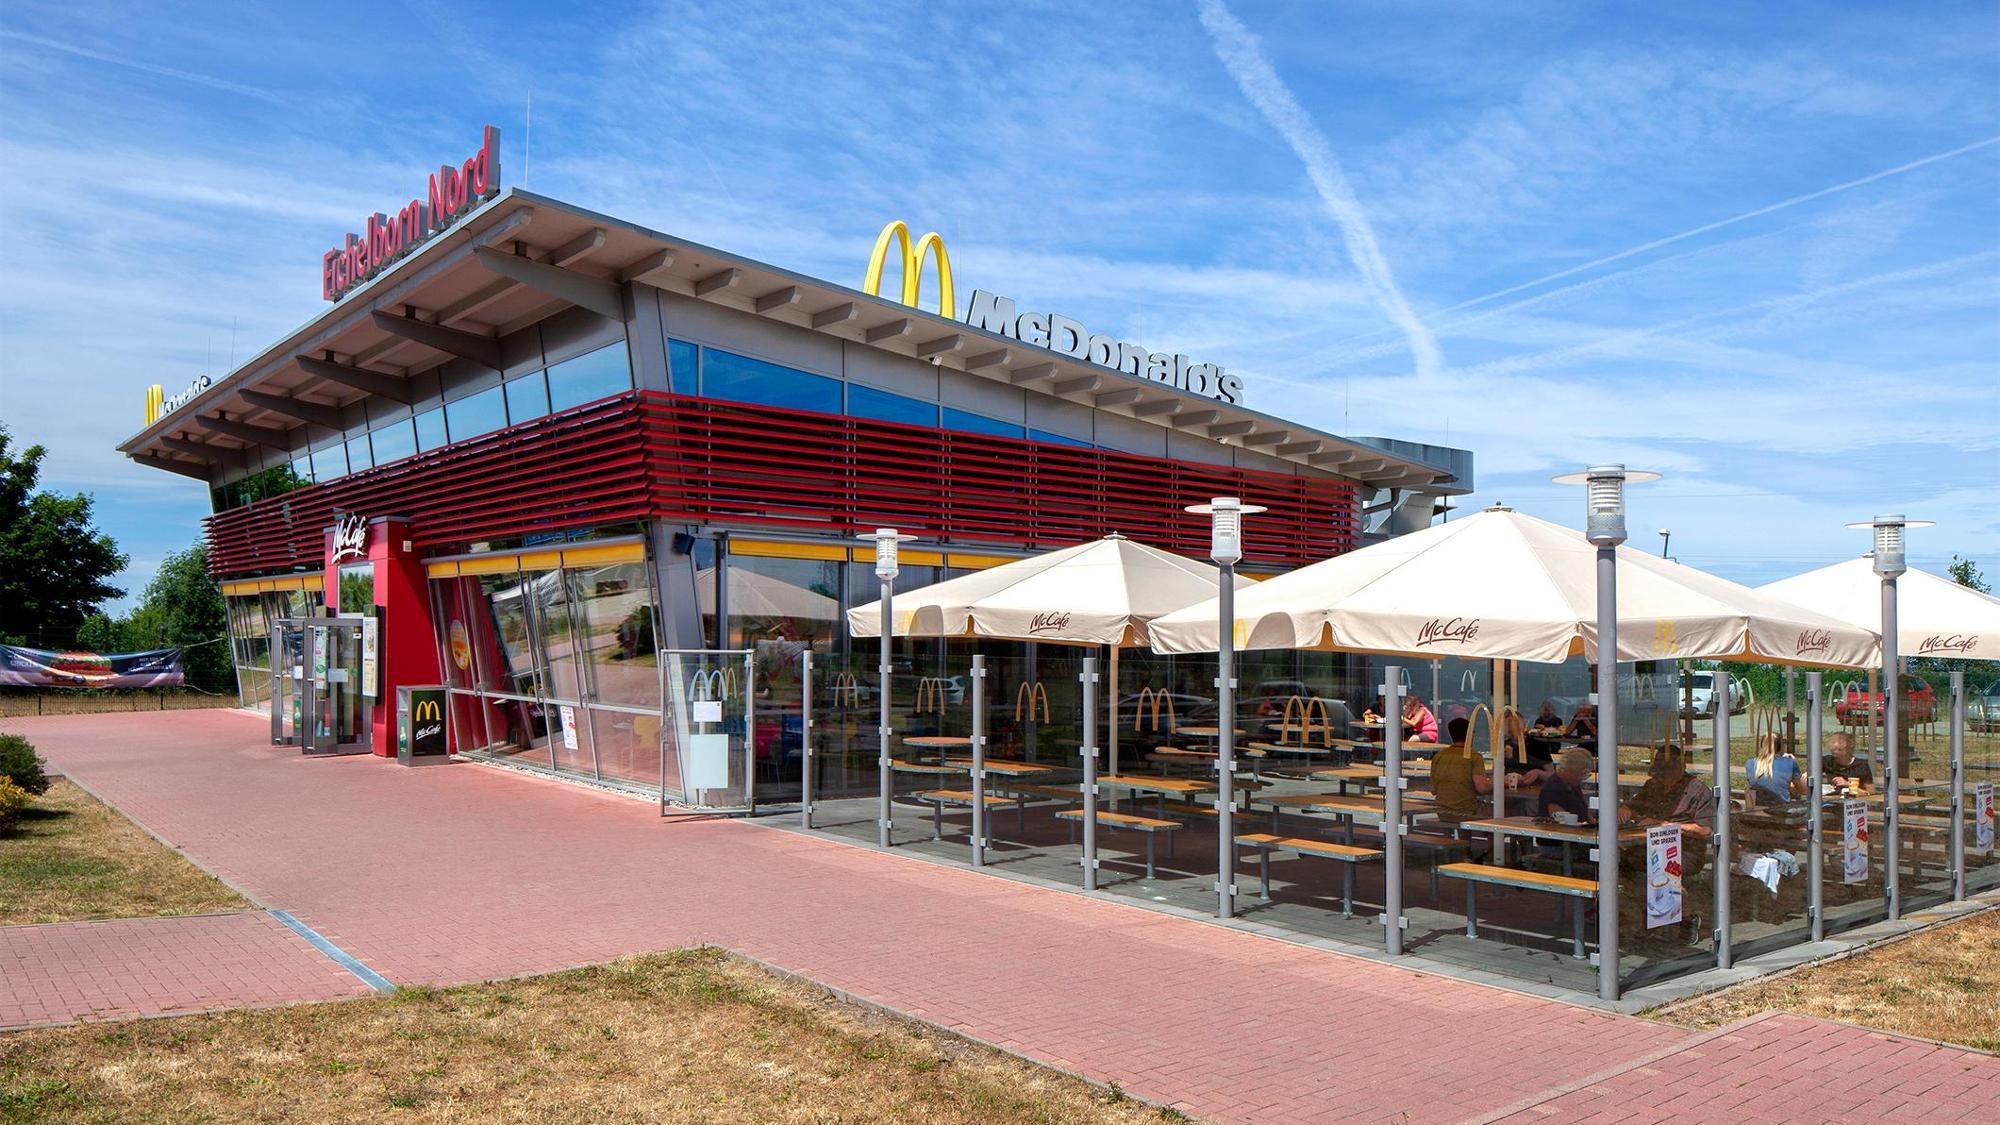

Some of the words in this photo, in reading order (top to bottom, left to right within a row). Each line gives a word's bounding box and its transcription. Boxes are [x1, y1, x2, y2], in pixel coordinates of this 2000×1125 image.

[323, 199, 425, 301] Eichelborn
[428, 125, 498, 230] Nord
[966, 288, 1244, 406] McDonald's
[332, 515, 367, 563] McCafé
[1029, 611, 1071, 633] McCafé
[1416, 617, 1480, 646] McCafé
[1797, 628, 1832, 655] McCafé
[1918, 635, 1980, 654] McCafé
